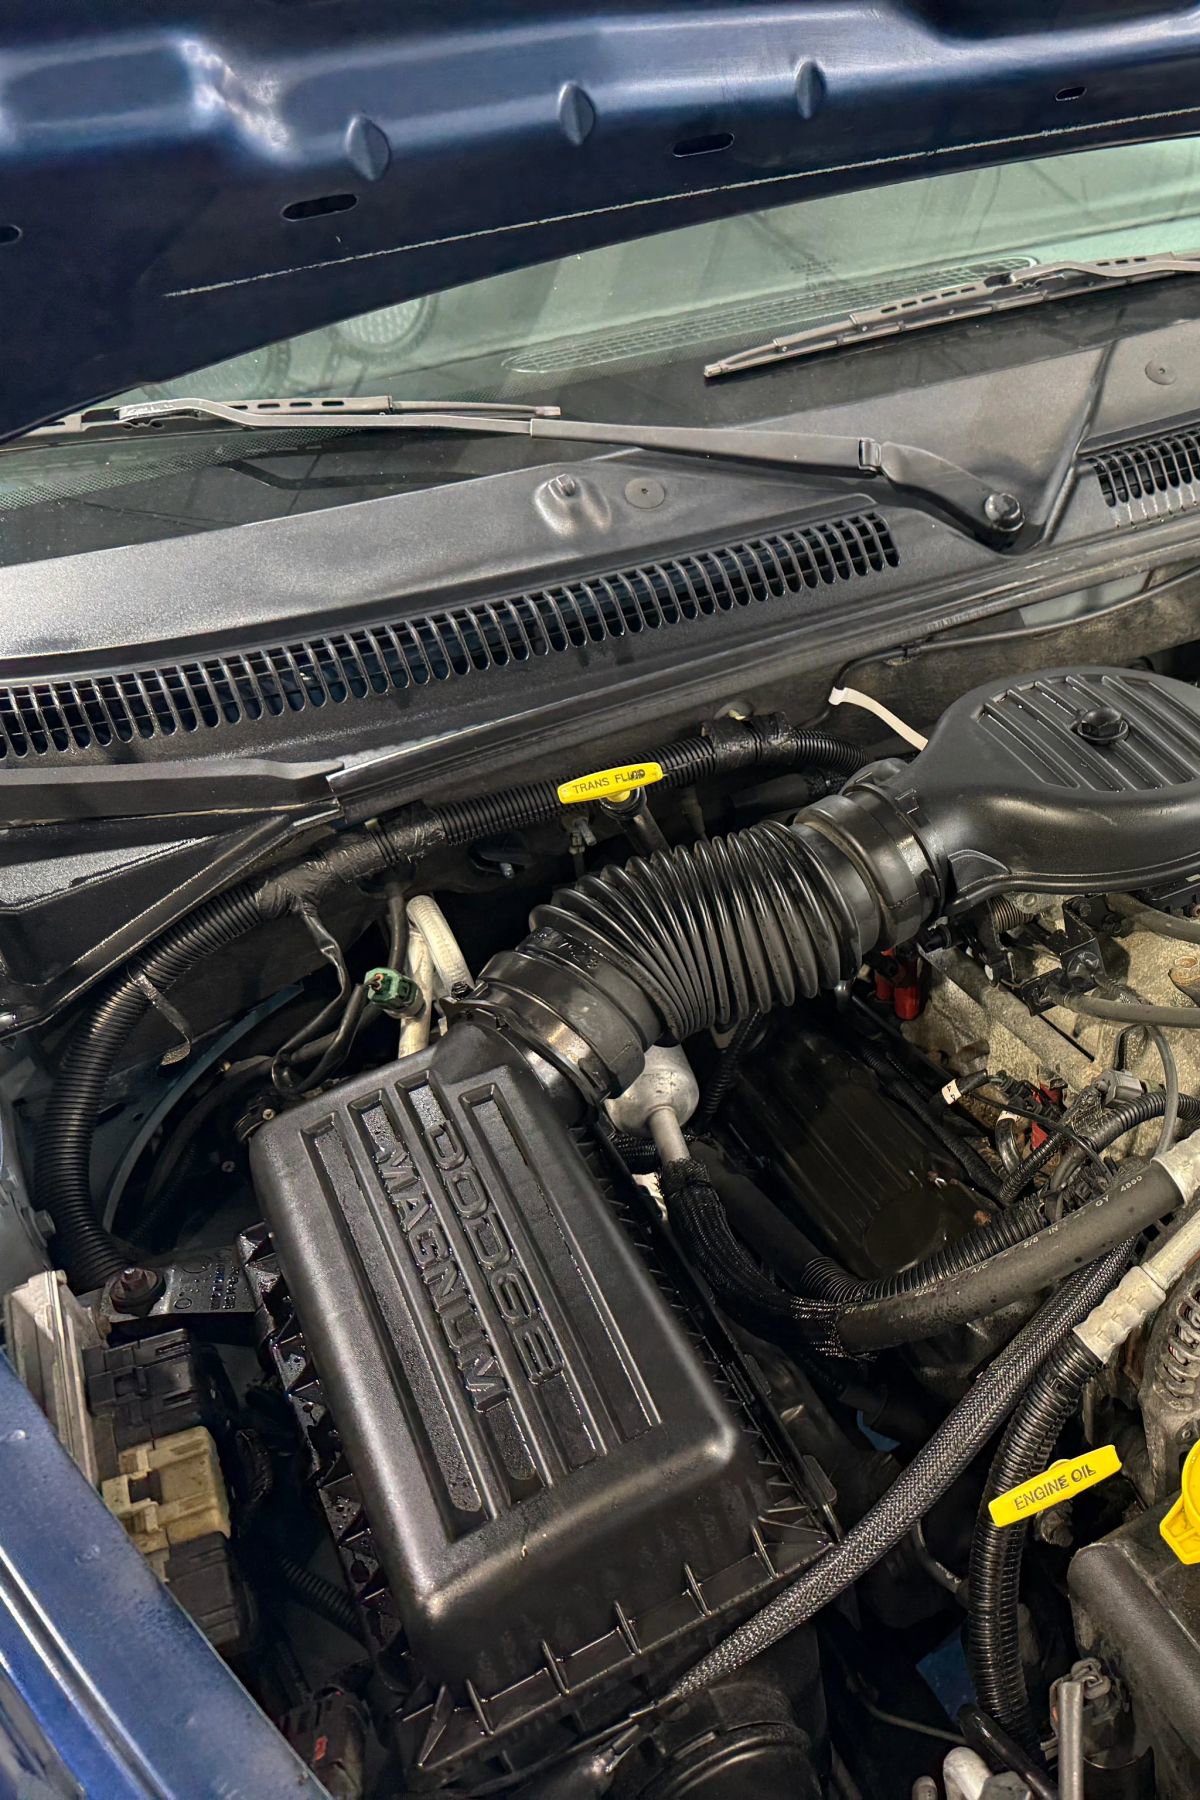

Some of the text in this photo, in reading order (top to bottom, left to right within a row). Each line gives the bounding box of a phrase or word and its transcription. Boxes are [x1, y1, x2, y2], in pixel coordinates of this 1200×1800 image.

[573, 777, 609, 793] TRANS
[424, 1119, 564, 1386] DODGE
[1049, 1225, 1059, 1236] IN
[374, 1147, 512, 1414] MAGNUM
[1012, 1461, 1096, 1510] ENGINE OIL
